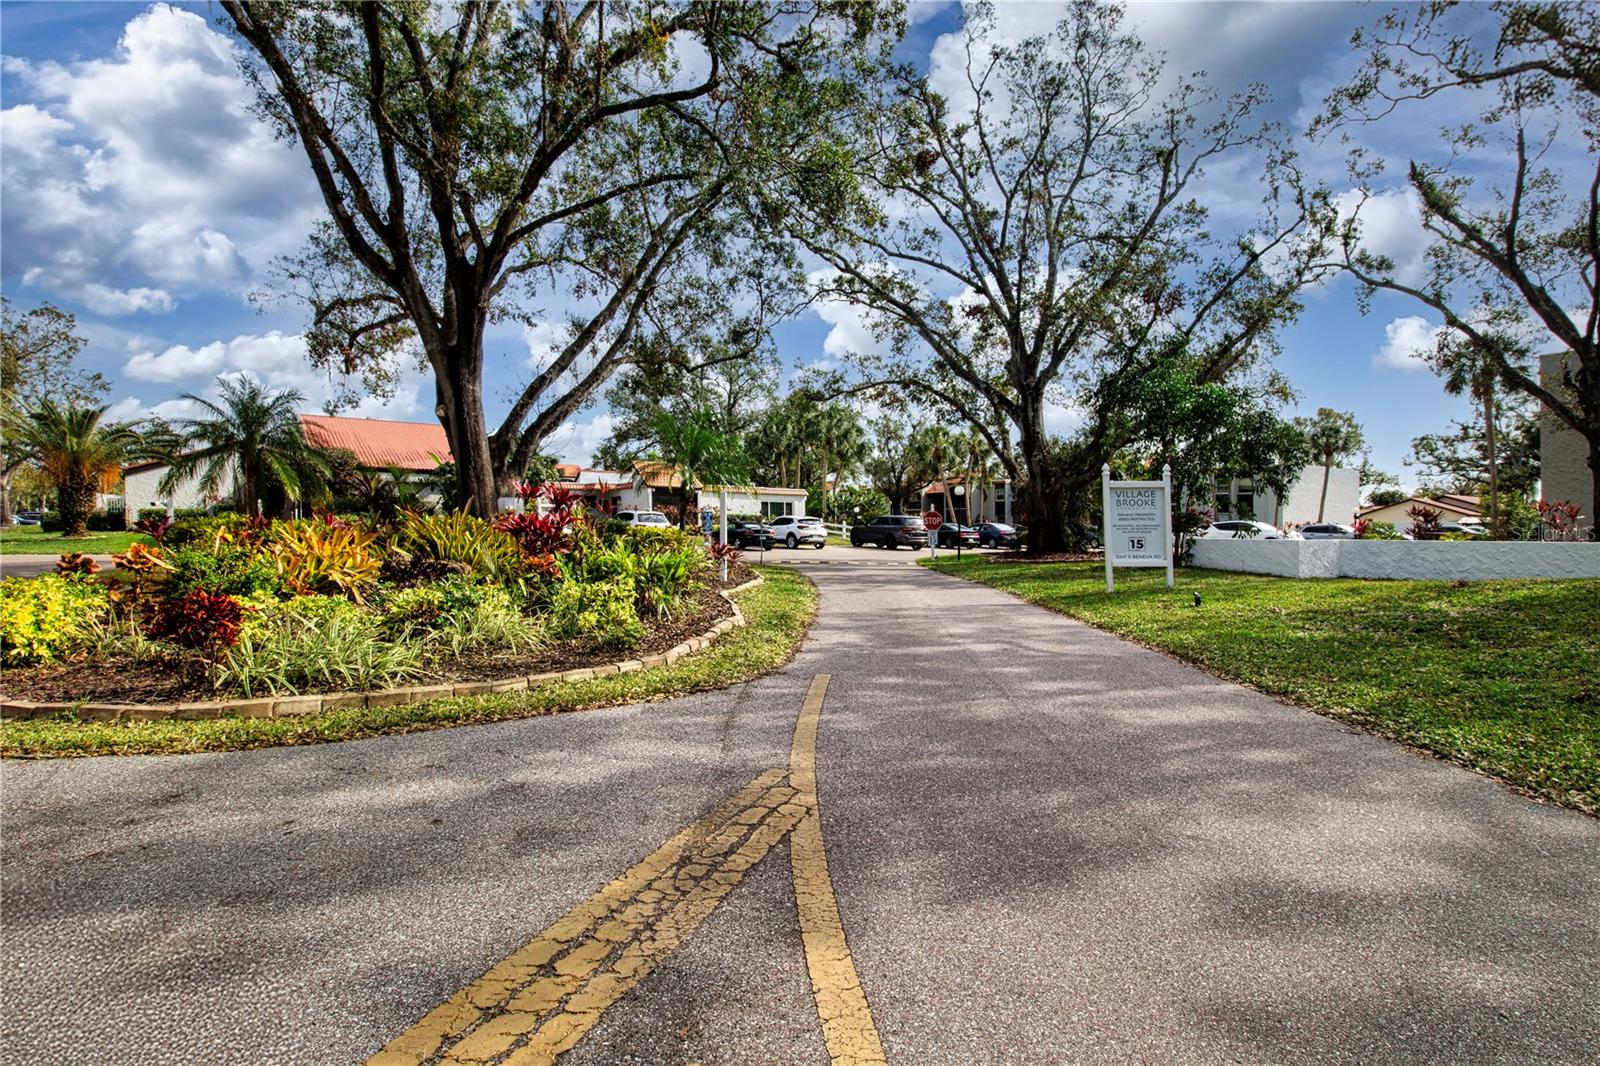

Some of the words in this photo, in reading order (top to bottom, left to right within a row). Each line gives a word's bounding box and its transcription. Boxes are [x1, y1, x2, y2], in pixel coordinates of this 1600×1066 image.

[1115, 490, 1156, 498] VILLAGE
[1116, 499, 1156, 507] BROOKE
[924, 517, 941, 525] STOP
[1129, 539, 1144, 549] 15
